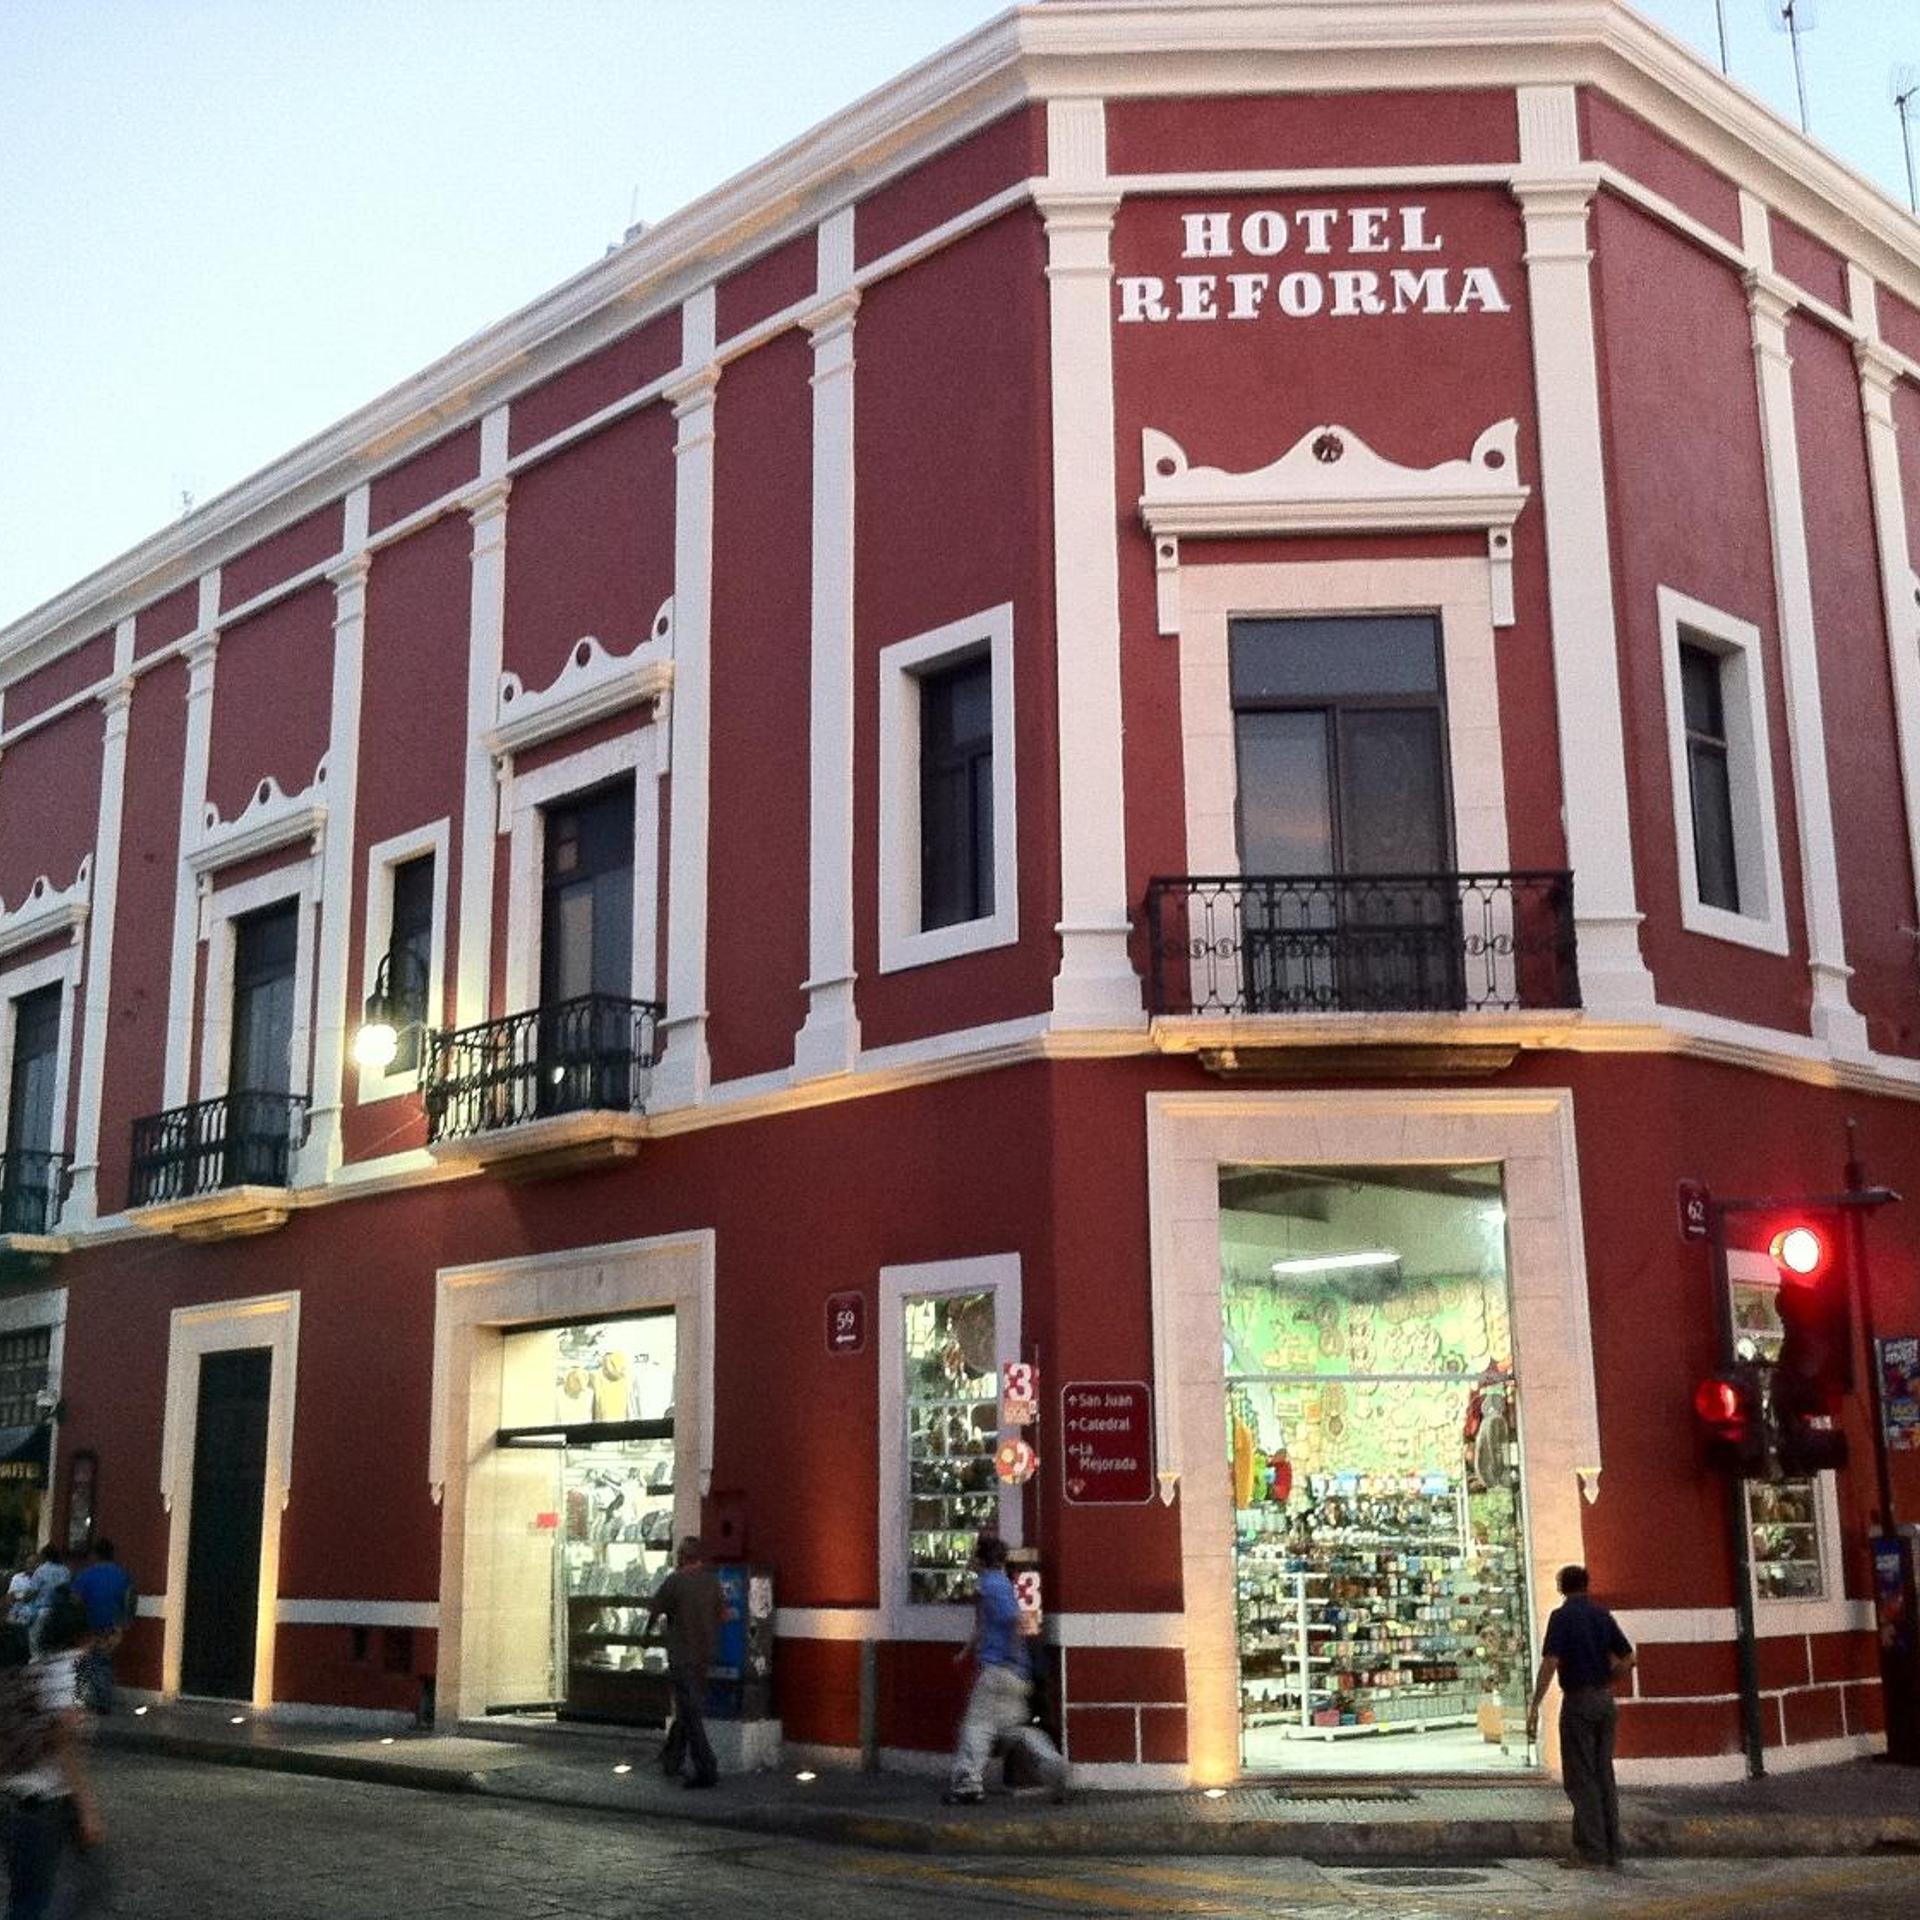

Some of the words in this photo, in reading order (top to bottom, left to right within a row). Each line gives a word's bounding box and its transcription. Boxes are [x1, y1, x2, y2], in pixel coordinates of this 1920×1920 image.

[1181, 206, 1444, 259] HOTEL
[1116, 267, 1511, 323] REFORMA
[1688, 1200, 1704, 1220] 62
[837, 1310, 855, 1330] 59
[1079, 1393, 1101, 1407] San
[1104, 1393, 1133, 1407] Juan
[1079, 1417, 1130, 1431] Catedral
[1080, 1442, 1093, 1455] La
[1080, 1457, 1137, 1473] Mejorada
